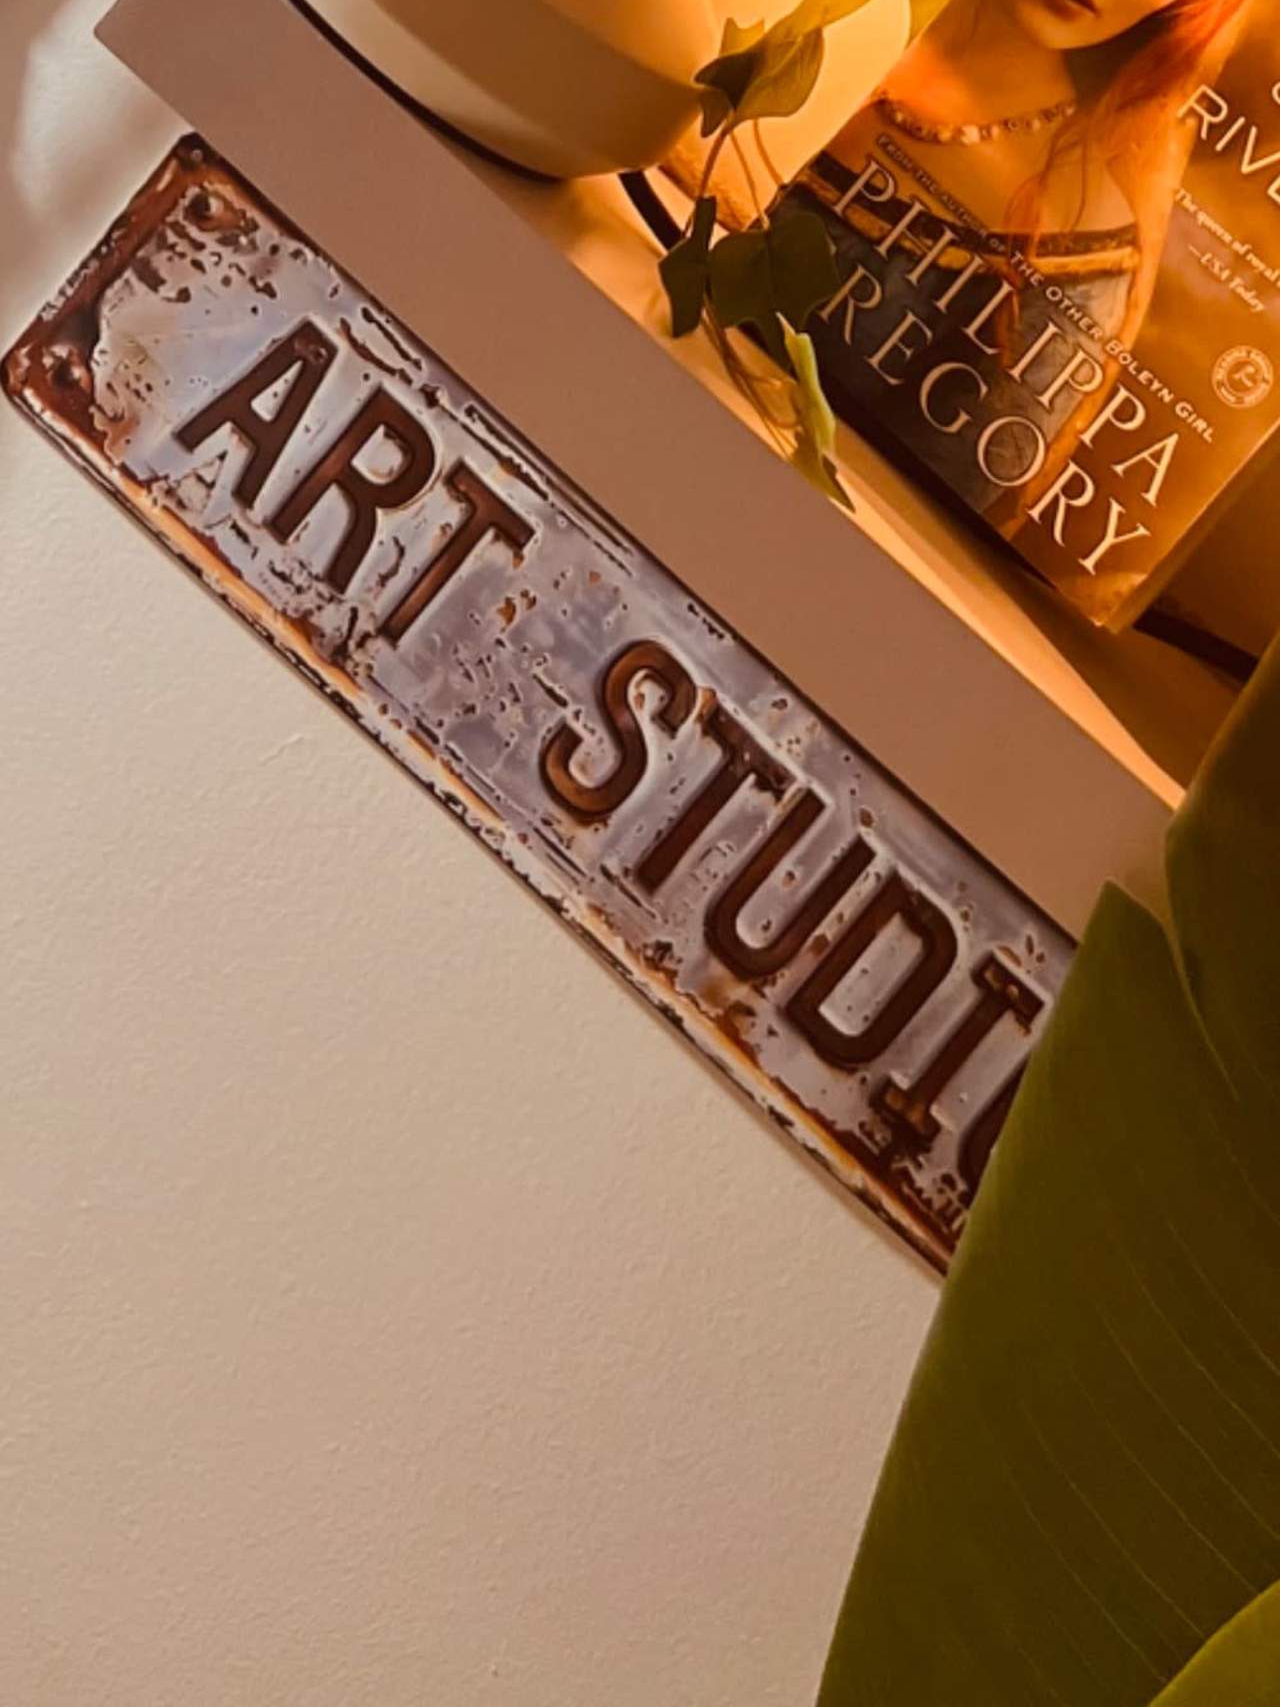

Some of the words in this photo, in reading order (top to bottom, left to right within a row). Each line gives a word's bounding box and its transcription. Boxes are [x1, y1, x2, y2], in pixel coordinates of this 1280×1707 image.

[831, 160, 1179, 507] PHILIPPA
[875, 133, 912, 170] FROM
[909, 163, 938, 193] THE
[1008, 250, 1046, 289] THE
[1044, 284, 1106, 341] OTHER
[1103, 338, 1176, 406] BOLEYN
[1173, 398, 1219, 443] GIRL
[1194, 210, 1234, 246] queen
[1229, 240, 1250, 257] of
[1242, 253, 1280, 282] royal
[1230, 276, 1265, 312] Today
[818, 265, 1152, 574] REGORY
[173, 322, 537, 647] ART
[538, 640, 1047, 1187] STUDI
